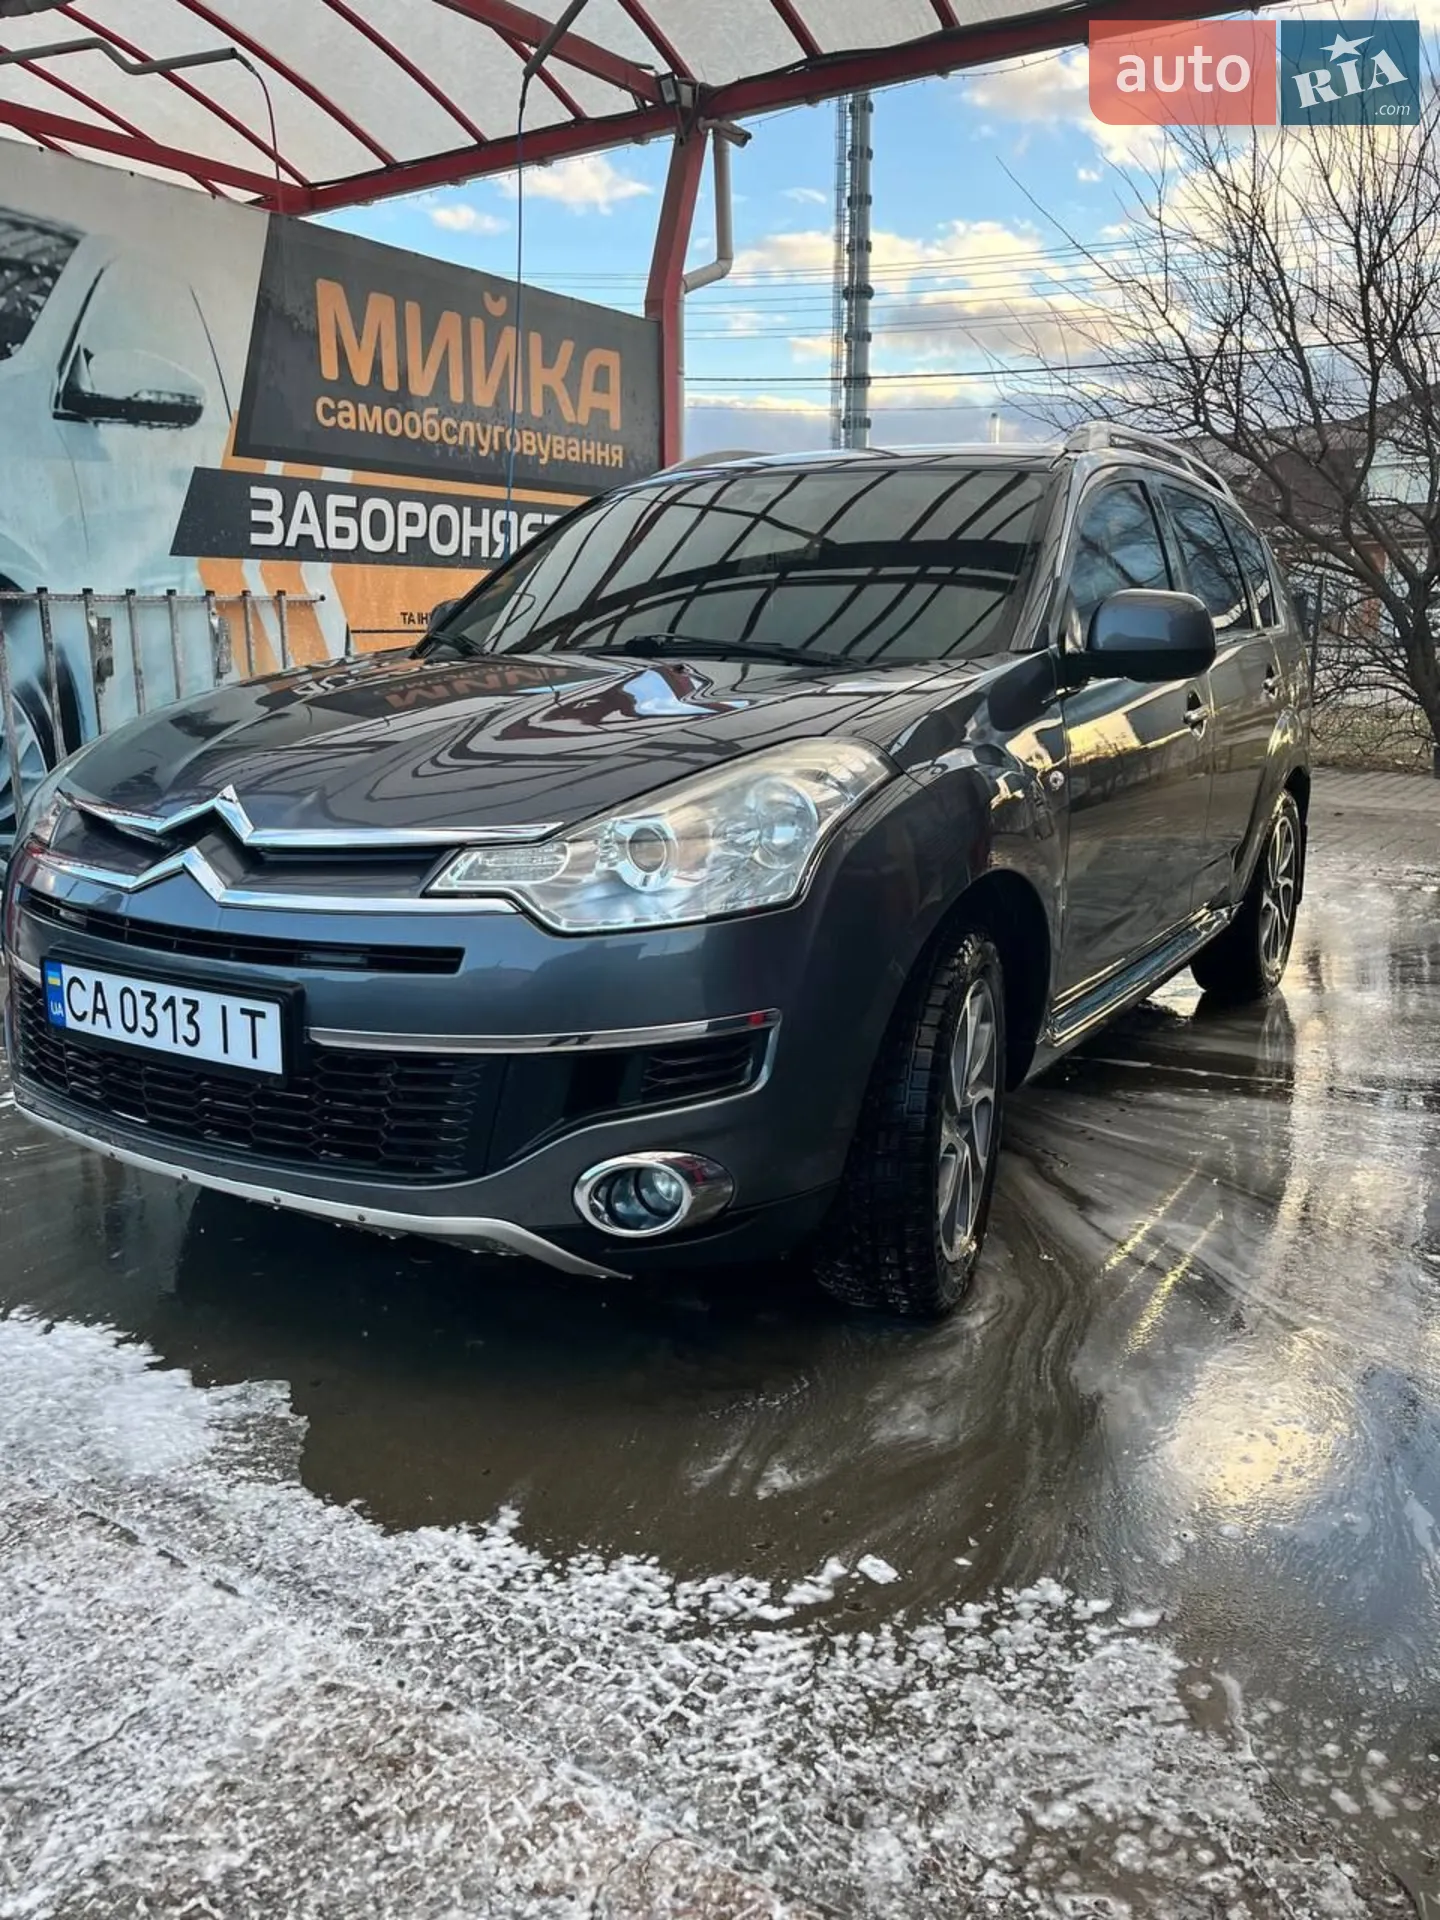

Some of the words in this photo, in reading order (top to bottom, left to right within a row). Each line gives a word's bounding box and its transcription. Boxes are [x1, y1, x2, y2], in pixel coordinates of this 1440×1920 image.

[316, 278, 622, 431] МИЙКА
[315, 395, 624, 469] самообслуговування
[50, 1000, 65, 1017] UA
[66, 976, 112, 1029] CA
[119, 986, 201, 1047] 0313
[221, 1004, 266, 1059] IT
